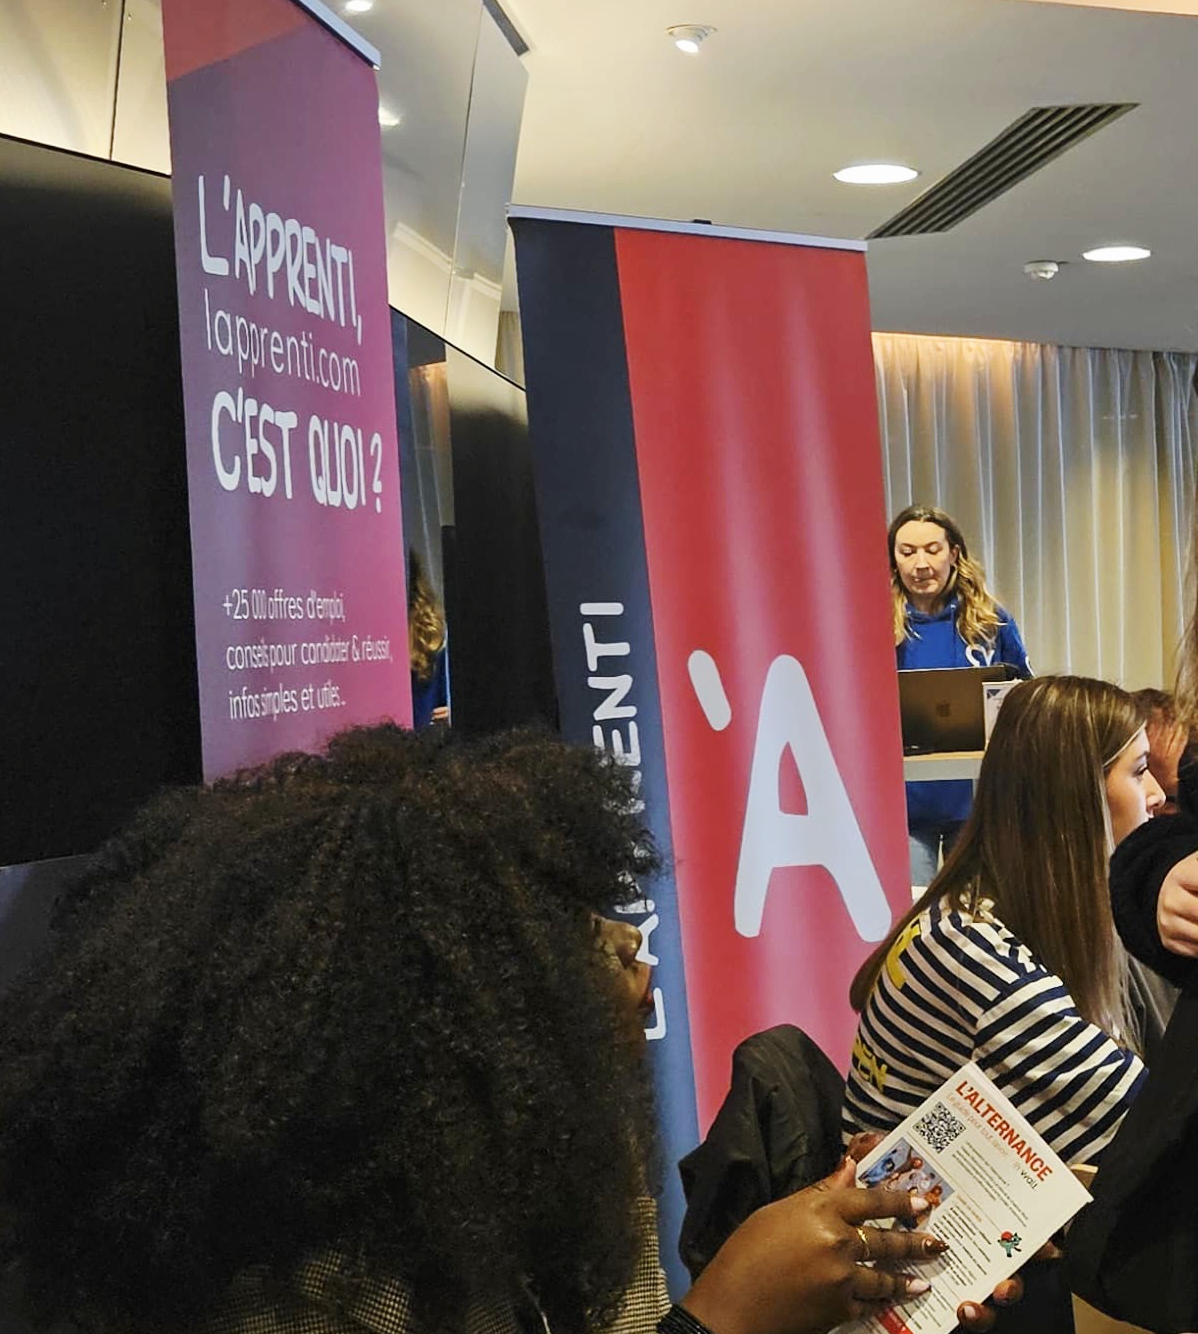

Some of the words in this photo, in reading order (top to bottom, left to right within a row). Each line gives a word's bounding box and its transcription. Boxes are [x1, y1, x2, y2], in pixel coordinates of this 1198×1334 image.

[199, 175, 362, 346] L'APPRENTI,
[204, 288, 361, 396] lapprenti.com
[212, 387, 297, 499] C'EST
[310, 415, 366, 510] QUOI
[371, 432, 383, 513] ?
[223, 589, 250, 620] +25
[252, 589, 267, 619] 000
[268, 589, 303, 619] offres
[226, 637, 269, 670] conseils
[270, 643, 297, 674] pour
[301, 635, 350, 664] candidater
[351, 635, 360, 662] &
[229, 686, 260, 719] infos
[261, 682, 298, 721] simples
[301, 684, 315, 710] et
[956, 1081, 1053, 1181] L'ALTERNANCE
